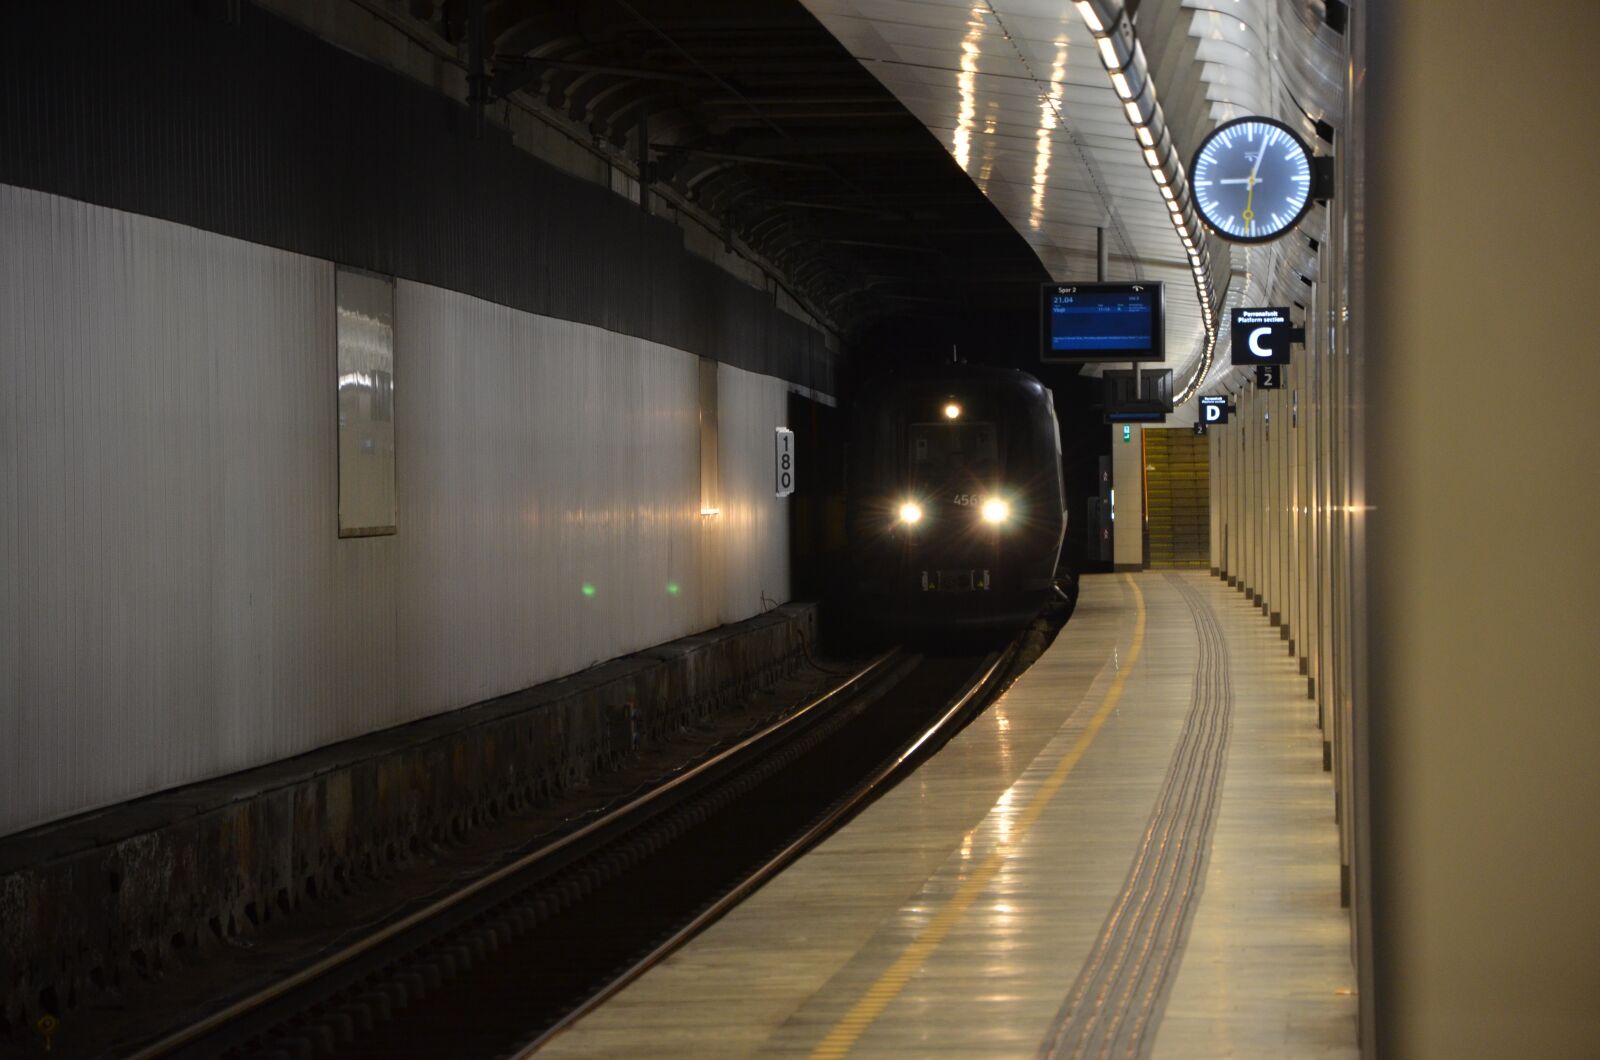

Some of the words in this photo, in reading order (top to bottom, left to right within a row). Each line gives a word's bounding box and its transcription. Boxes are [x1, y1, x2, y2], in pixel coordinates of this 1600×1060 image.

[1053, 296, 1073, 304] 21.04
[1248, 327, 1273, 357] C
[1263, 373, 1273, 386] 2
[1206, 405, 1220, 421] D
[1197, 426, 1203, 434] 2
